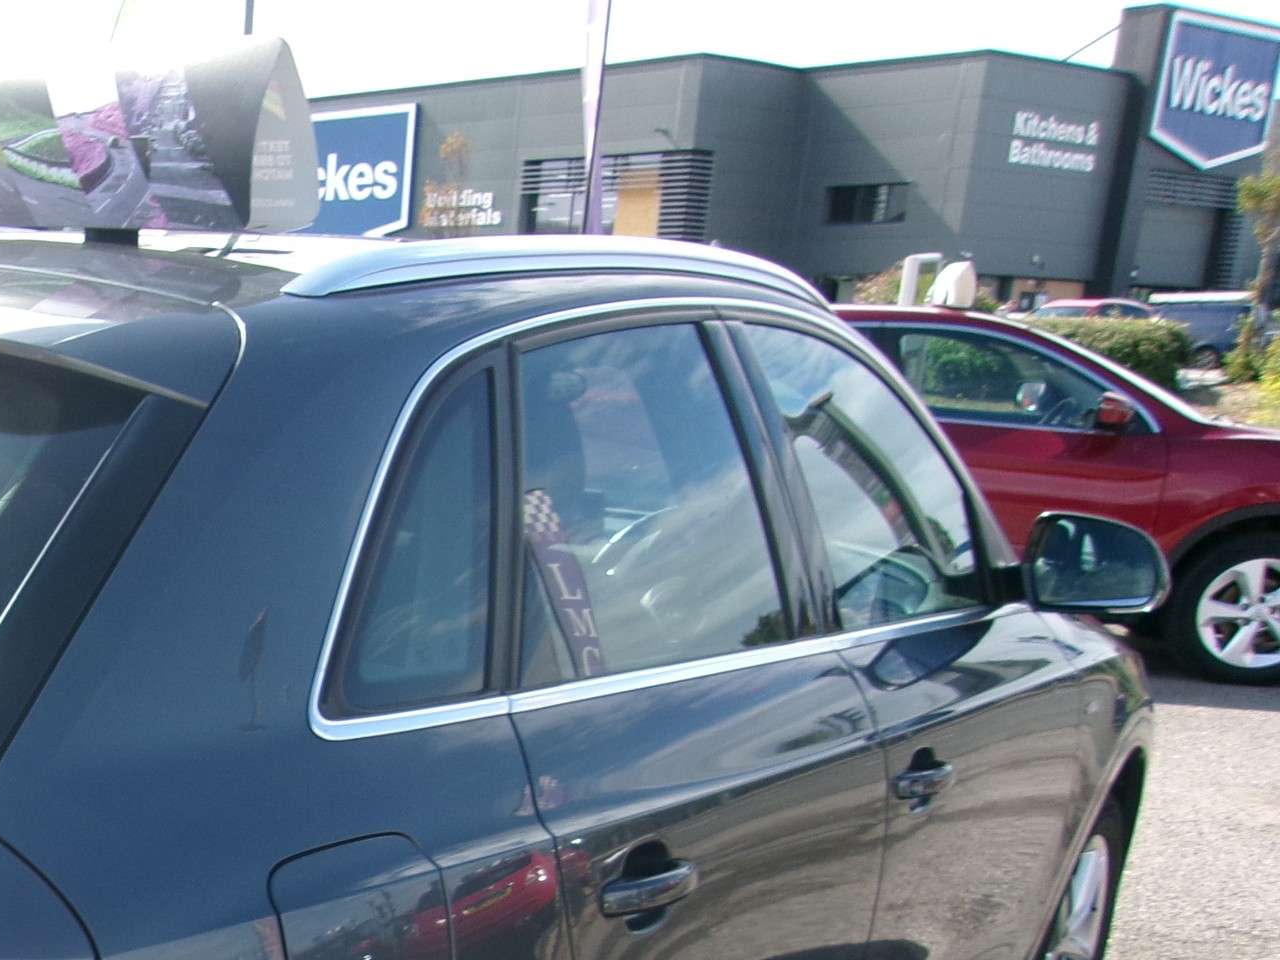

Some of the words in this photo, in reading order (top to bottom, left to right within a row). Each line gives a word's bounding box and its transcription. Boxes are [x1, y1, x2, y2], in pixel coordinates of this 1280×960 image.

[1170, 55, 1270, 122] Wickes
[1013, 110, 1086, 144] Kitchens
[1086, 121, 1099, 146] &
[1008, 139, 1095, 172] Bathrooms
